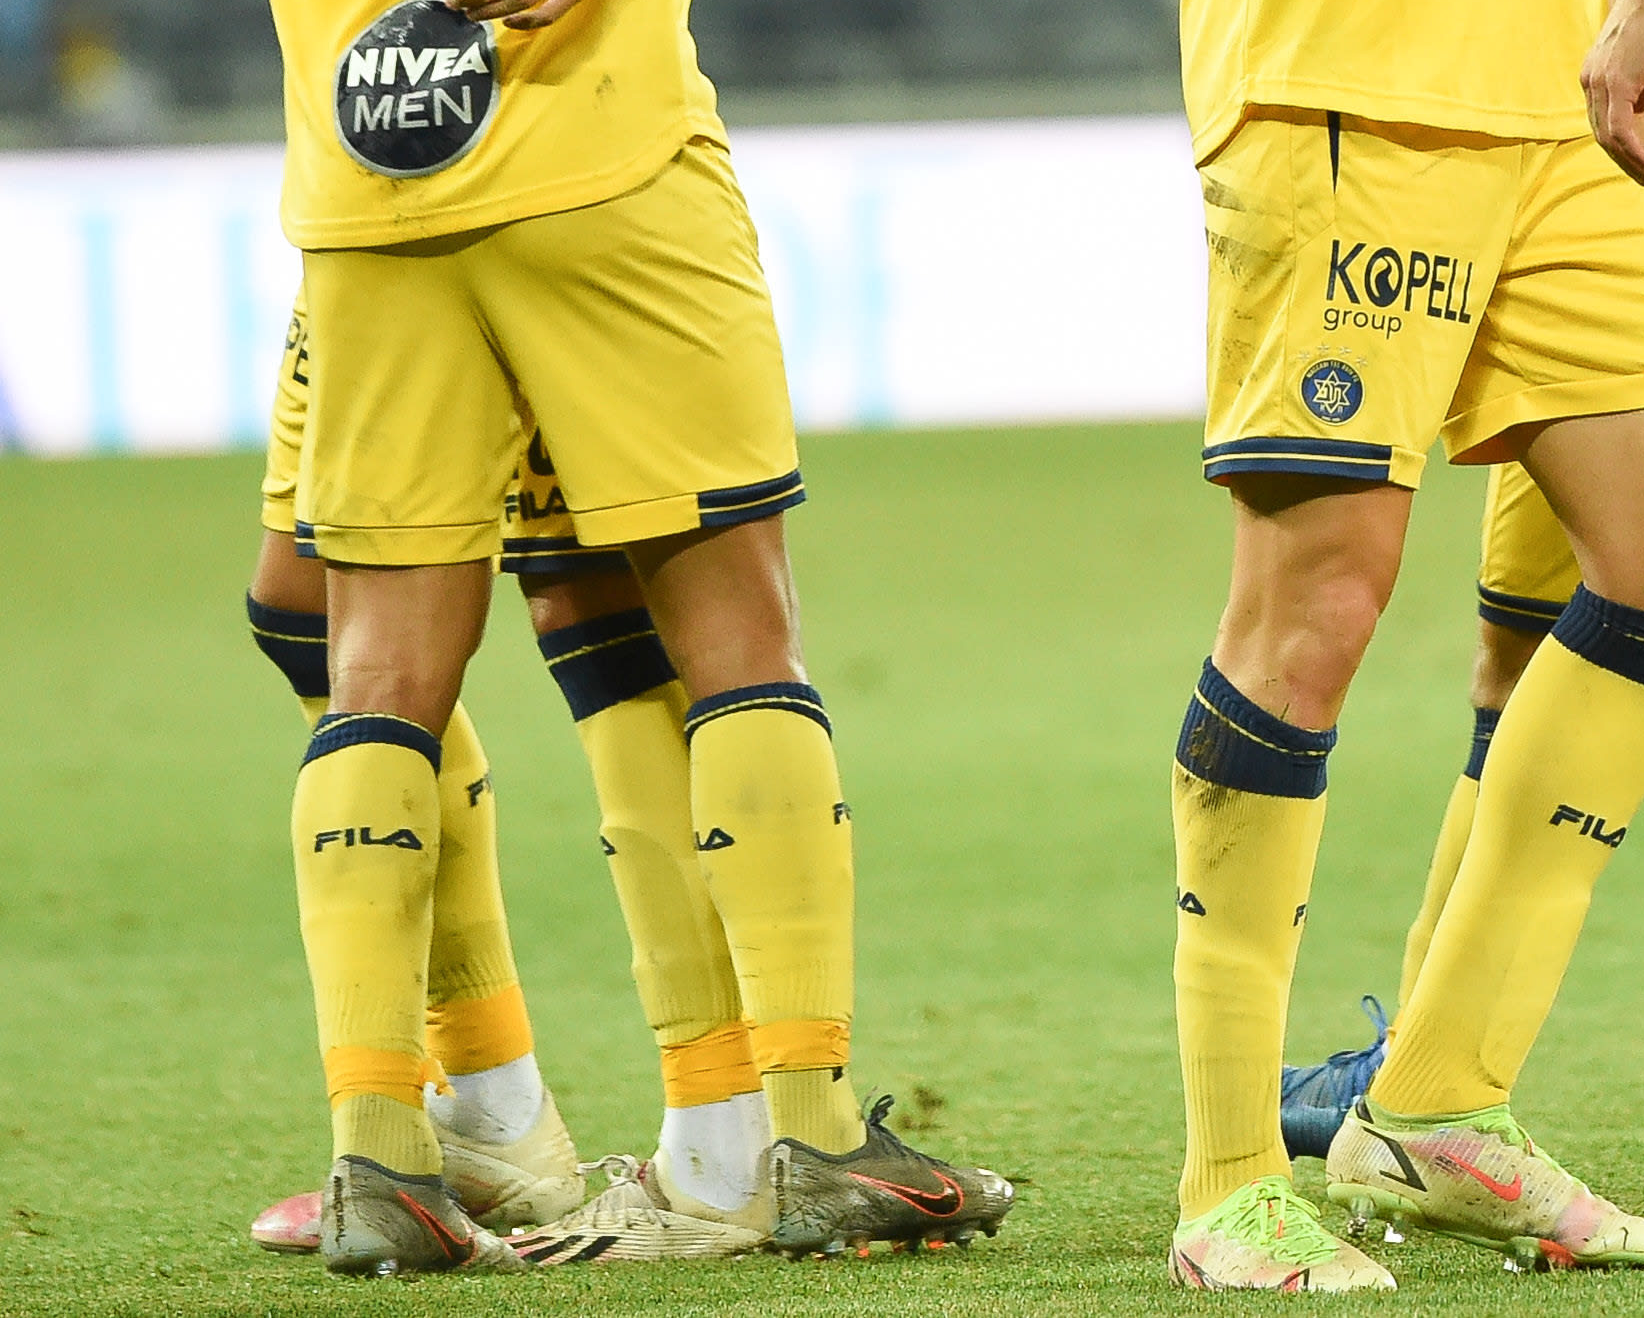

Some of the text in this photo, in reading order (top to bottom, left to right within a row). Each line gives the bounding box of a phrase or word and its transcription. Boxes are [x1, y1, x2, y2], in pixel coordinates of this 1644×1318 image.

[345, 41, 489, 88] NIVEA
[353, 85, 474, 133] MEN
[1326, 239, 1473, 325] KOPELL
[1322, 305, 1403, 341] group
[314, 827, 423, 853] FILA
[1549, 804, 1627, 849] FILA
